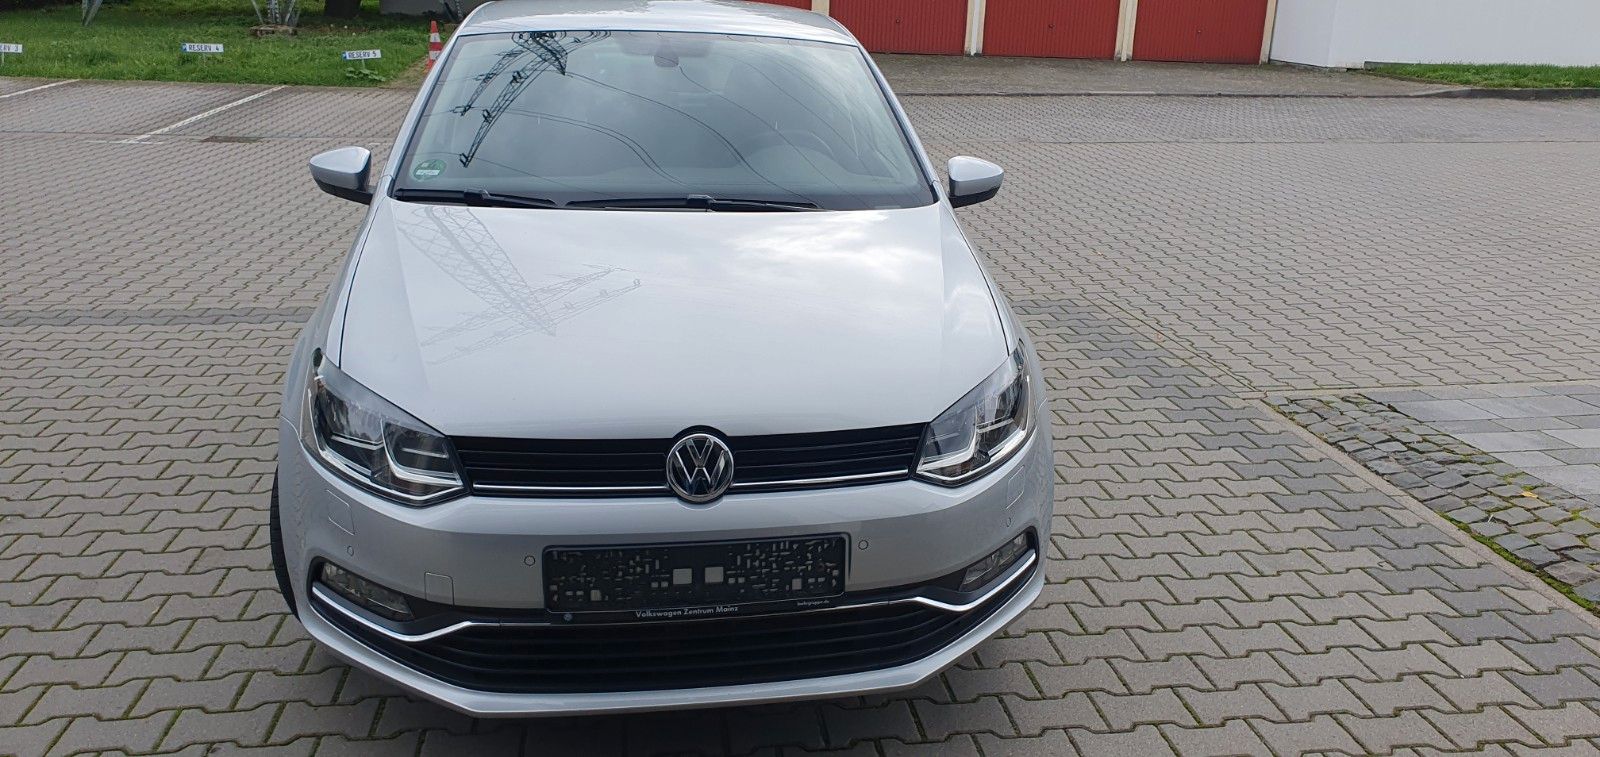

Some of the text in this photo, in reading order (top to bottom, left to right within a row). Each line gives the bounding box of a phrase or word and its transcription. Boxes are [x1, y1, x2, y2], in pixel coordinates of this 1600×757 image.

[668, 435, 732, 498] VW
[635, 605, 739, 618] Volkswagen Zentrum Mainz
